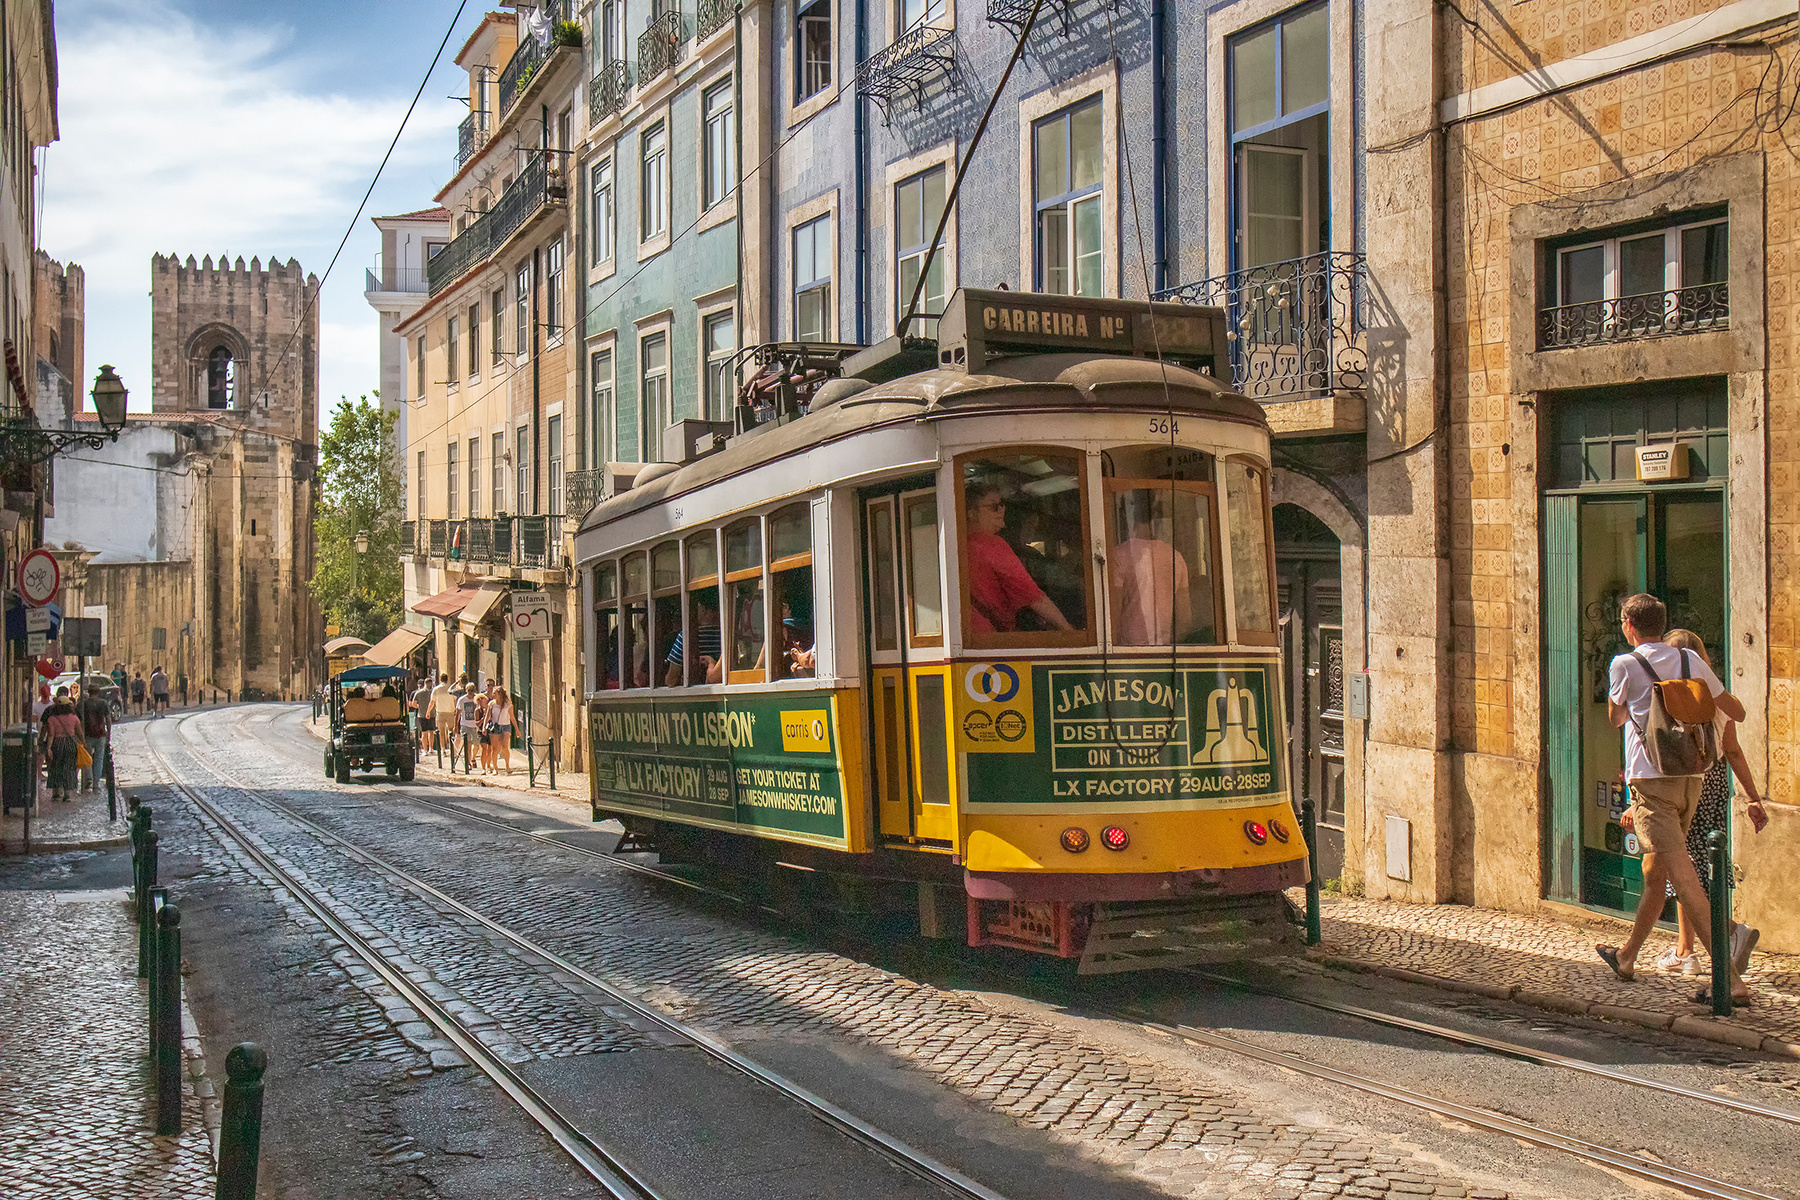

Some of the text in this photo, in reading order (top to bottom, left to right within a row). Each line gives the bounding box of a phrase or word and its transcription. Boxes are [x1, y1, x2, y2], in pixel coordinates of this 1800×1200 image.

[983, 306, 1088, 337] CARREIRA
[1100, 316, 1124, 338] Nº
[1149, 418, 1179, 435] 564
[675, 508, 683, 519] 564
[1057, 679, 1180, 712] JAMESON
[592, 711, 623, 742] FROM
[624, 711, 670, 744] DUBLIN
[671, 711, 691, 746] TO
[1088, 748, 1160, 766] ON TOUR
[628, 761, 645, 790] LX
[645, 763, 700, 798] FACTORY
[707, 769, 728, 783] 29 AUG
[736, 768, 820, 791] GET YOUR TICKET AT
[708, 787, 729, 801] 28 SEP
[1053, 780, 1080, 796] LX
[1086, 778, 1175, 796] FACTORY
